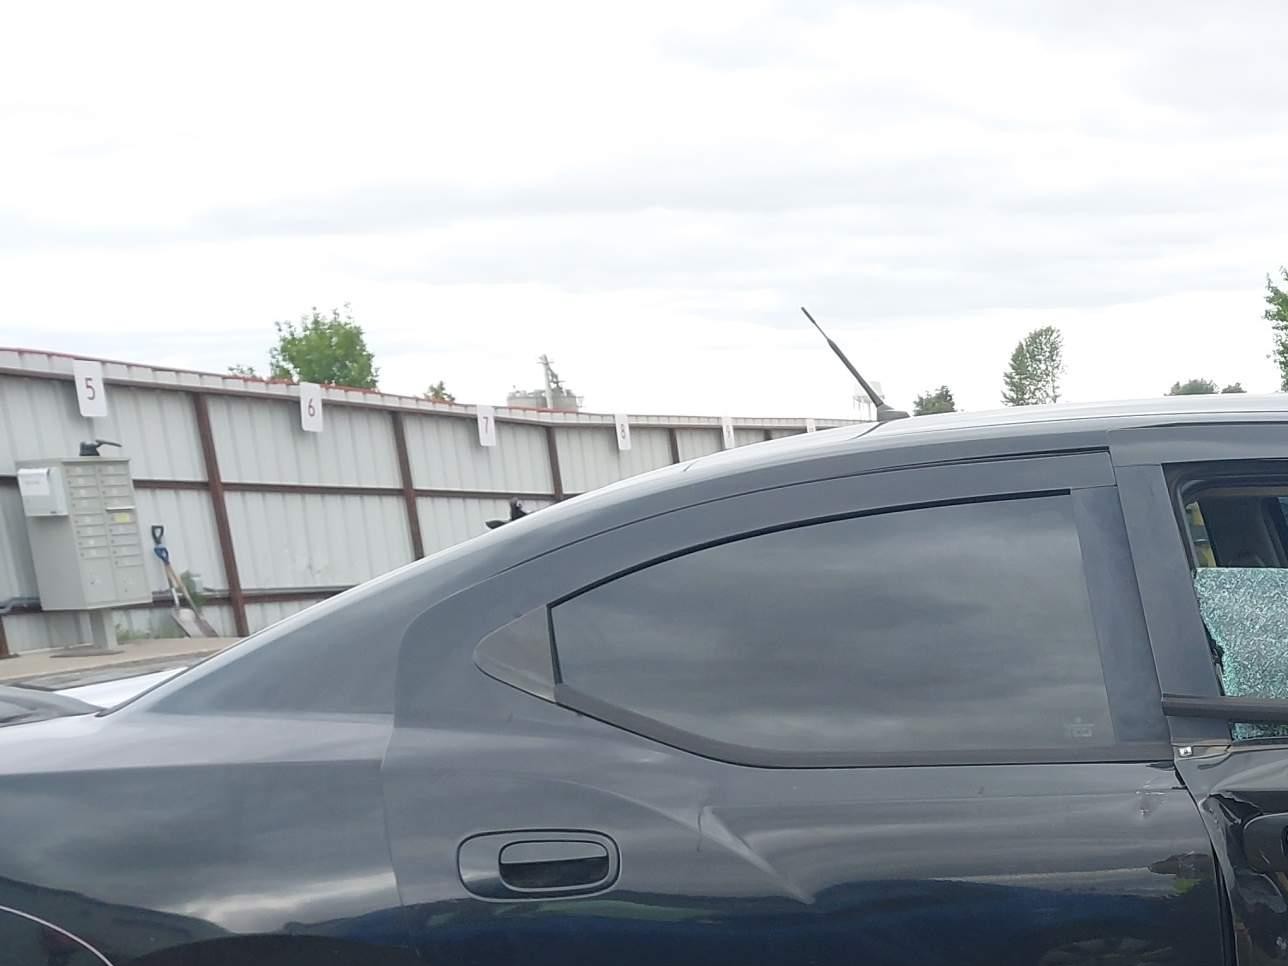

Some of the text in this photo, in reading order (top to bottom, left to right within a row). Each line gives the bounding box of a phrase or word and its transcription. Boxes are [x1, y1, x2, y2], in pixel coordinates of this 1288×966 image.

[84, 377, 96, 401] 5
[307, 397, 316, 417] 6
[482, 415, 489, 433] 7
